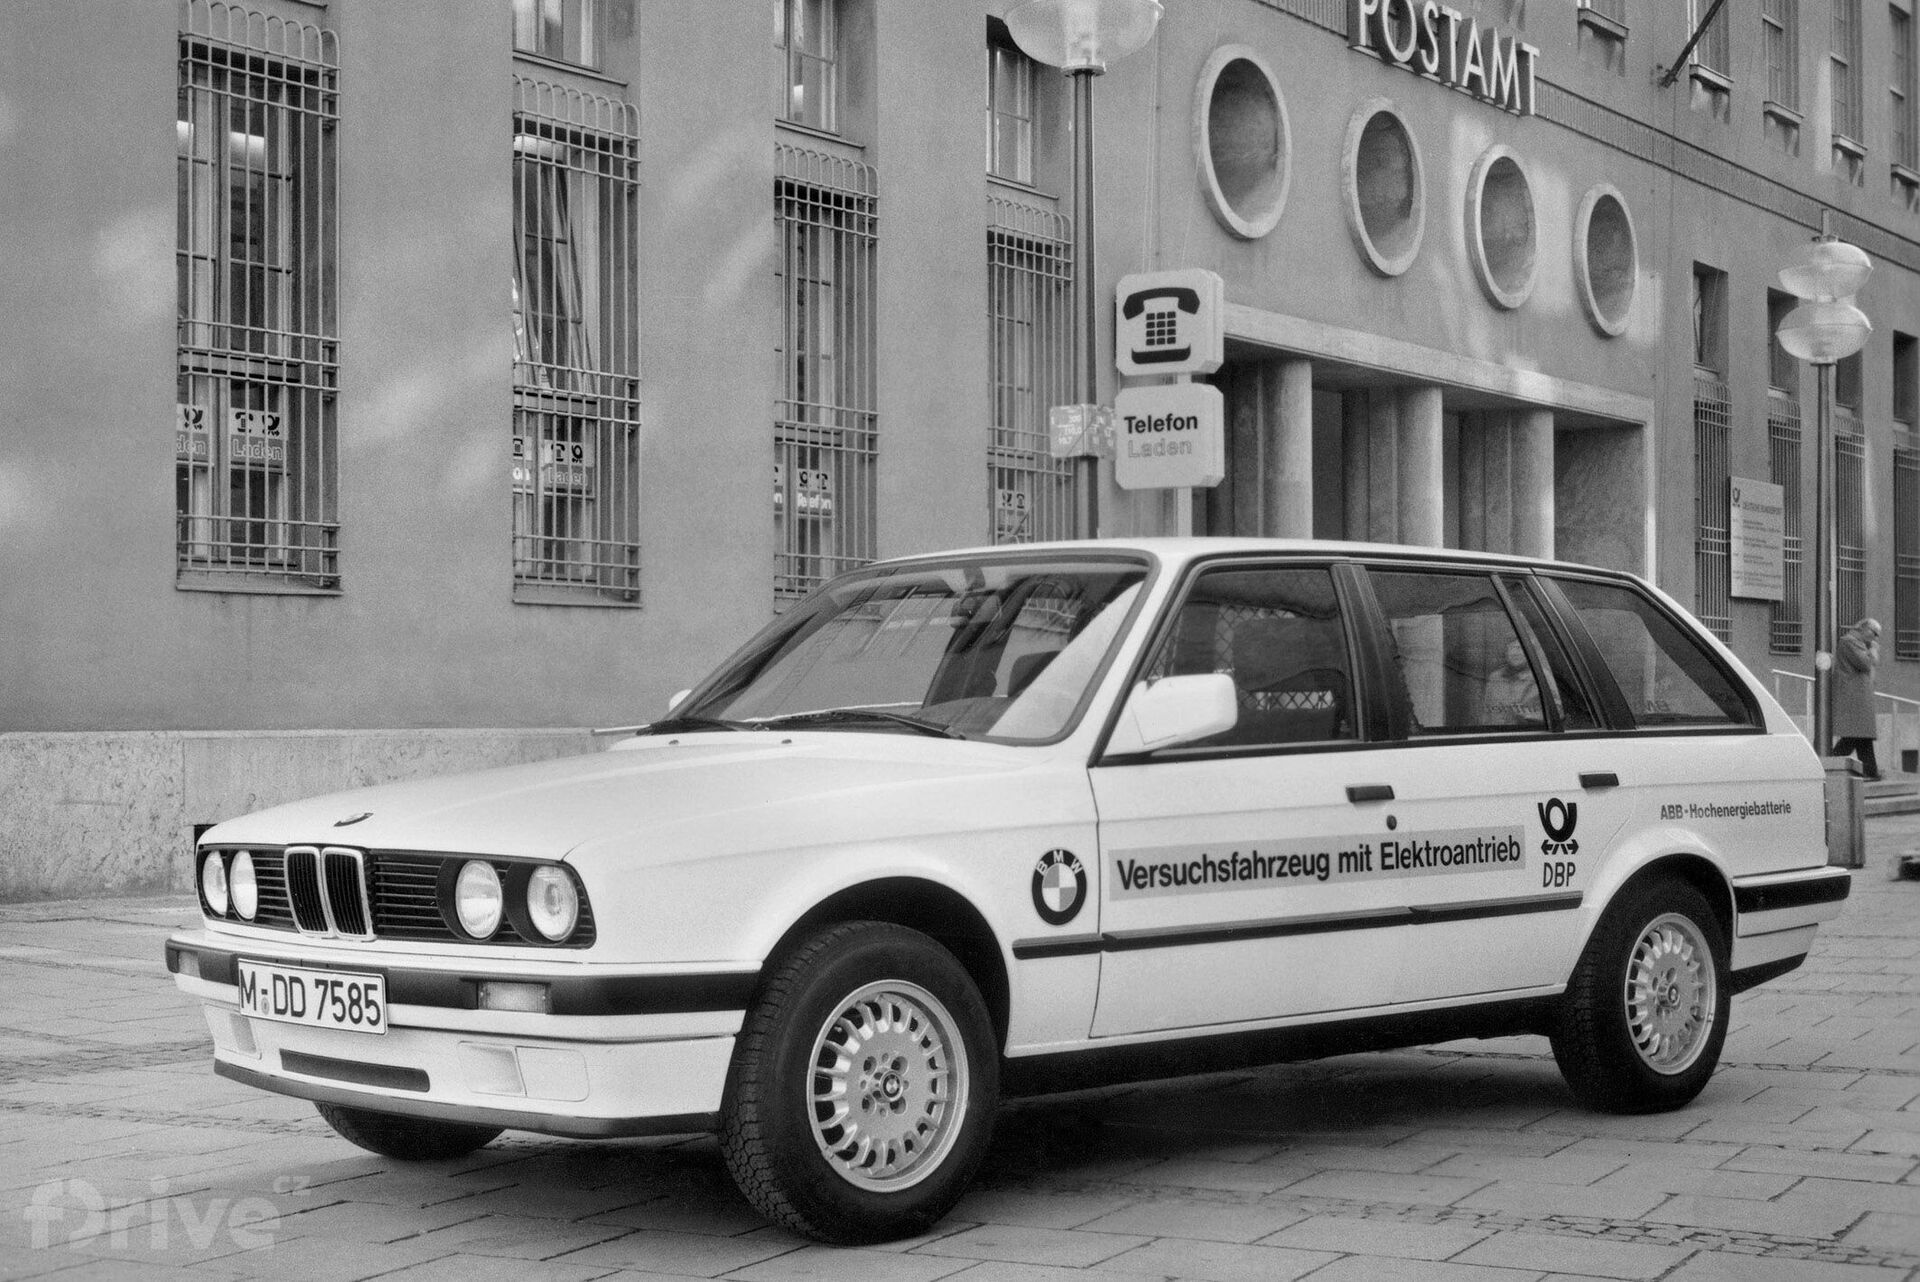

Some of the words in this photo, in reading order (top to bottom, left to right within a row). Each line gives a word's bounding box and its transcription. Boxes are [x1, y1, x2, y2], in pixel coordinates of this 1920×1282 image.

[1124, 413, 1198, 434] Telefon
[1127, 438, 1193, 458] Laden
[1036, 850, 1084, 877] BMW
[1117, 850, 1330, 890] Versuchsfahrzeug
[1338, 844, 1373, 874] mit
[1380, 835, 1521, 871] Elektroantrieb
[1543, 862, 1577, 888] DBP
[314, 978, 382, 1027] 7585
